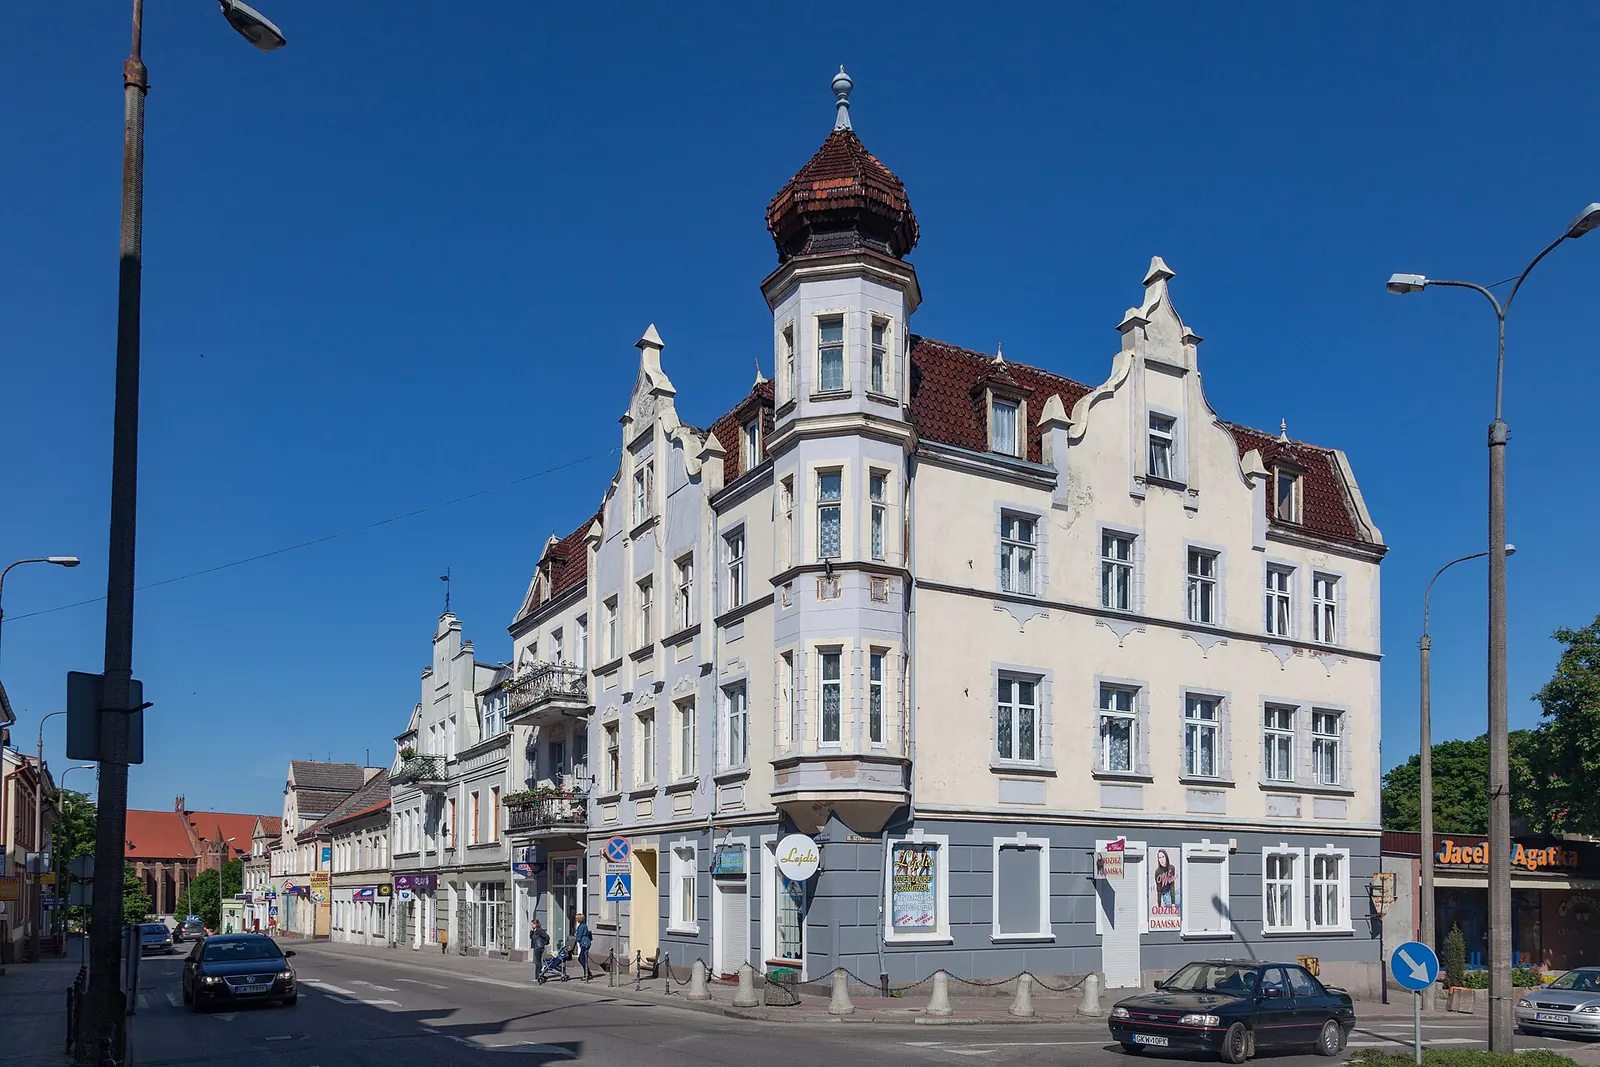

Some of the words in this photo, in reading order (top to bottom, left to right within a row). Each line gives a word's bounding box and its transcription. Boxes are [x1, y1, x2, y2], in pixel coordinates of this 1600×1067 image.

[780, 847, 818, 867] Lejdis
[893, 849, 934, 871] Lejdis
[1511, 843, 1578, 871] Agatka
[1151, 904, 1179, 915] ODZIEŻ
[1150, 919, 1180, 929] DAMSKA
